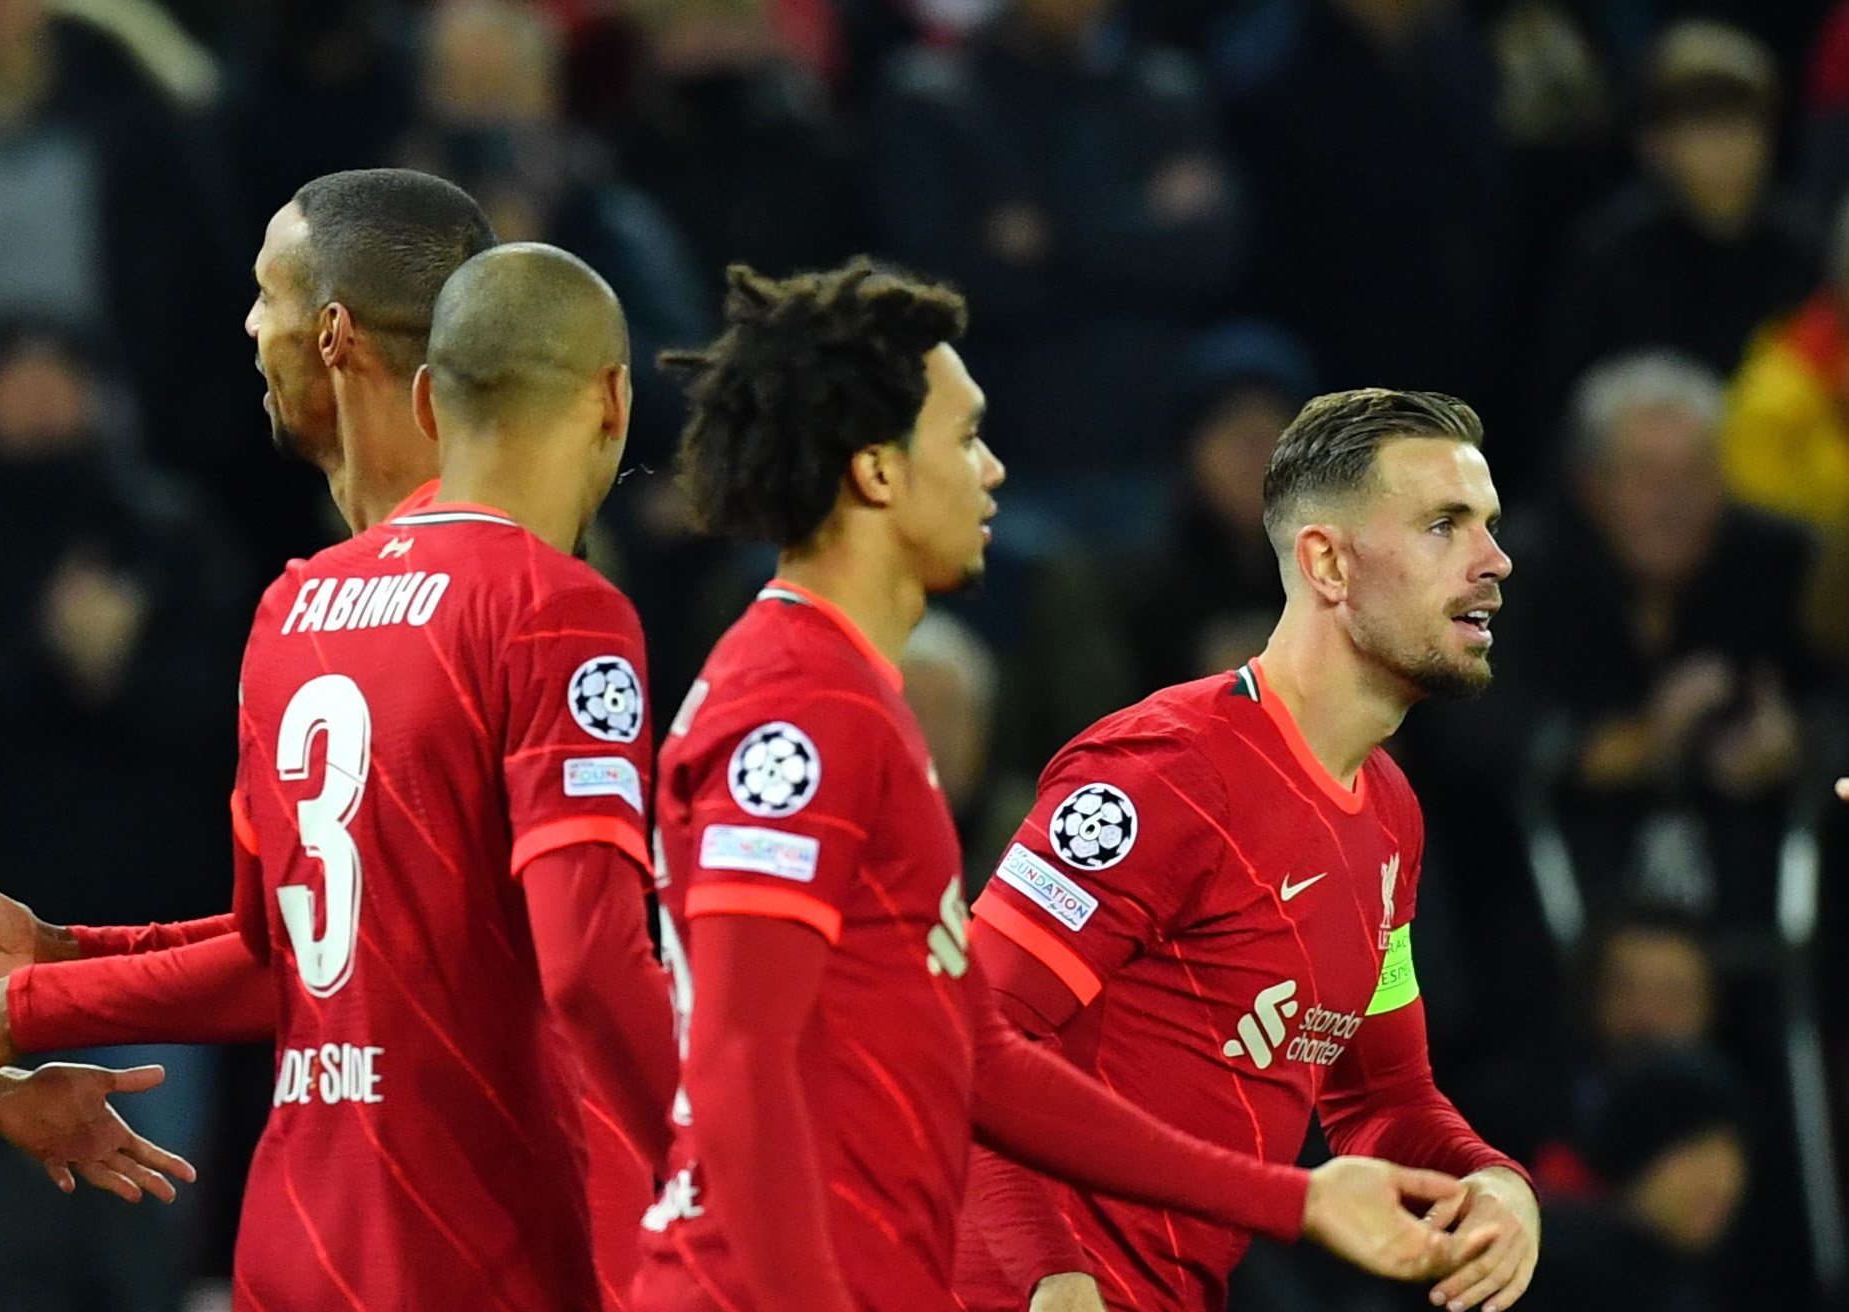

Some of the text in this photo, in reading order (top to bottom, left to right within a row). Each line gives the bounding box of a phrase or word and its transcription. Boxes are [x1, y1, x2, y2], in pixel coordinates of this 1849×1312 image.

[281, 571, 450, 635] FABINHO
[603, 683, 627, 713] 6
[277, 674, 372, 999] 3
[1079, 811, 1105, 842] 6
[319, 1042, 386, 1105] SIDE
